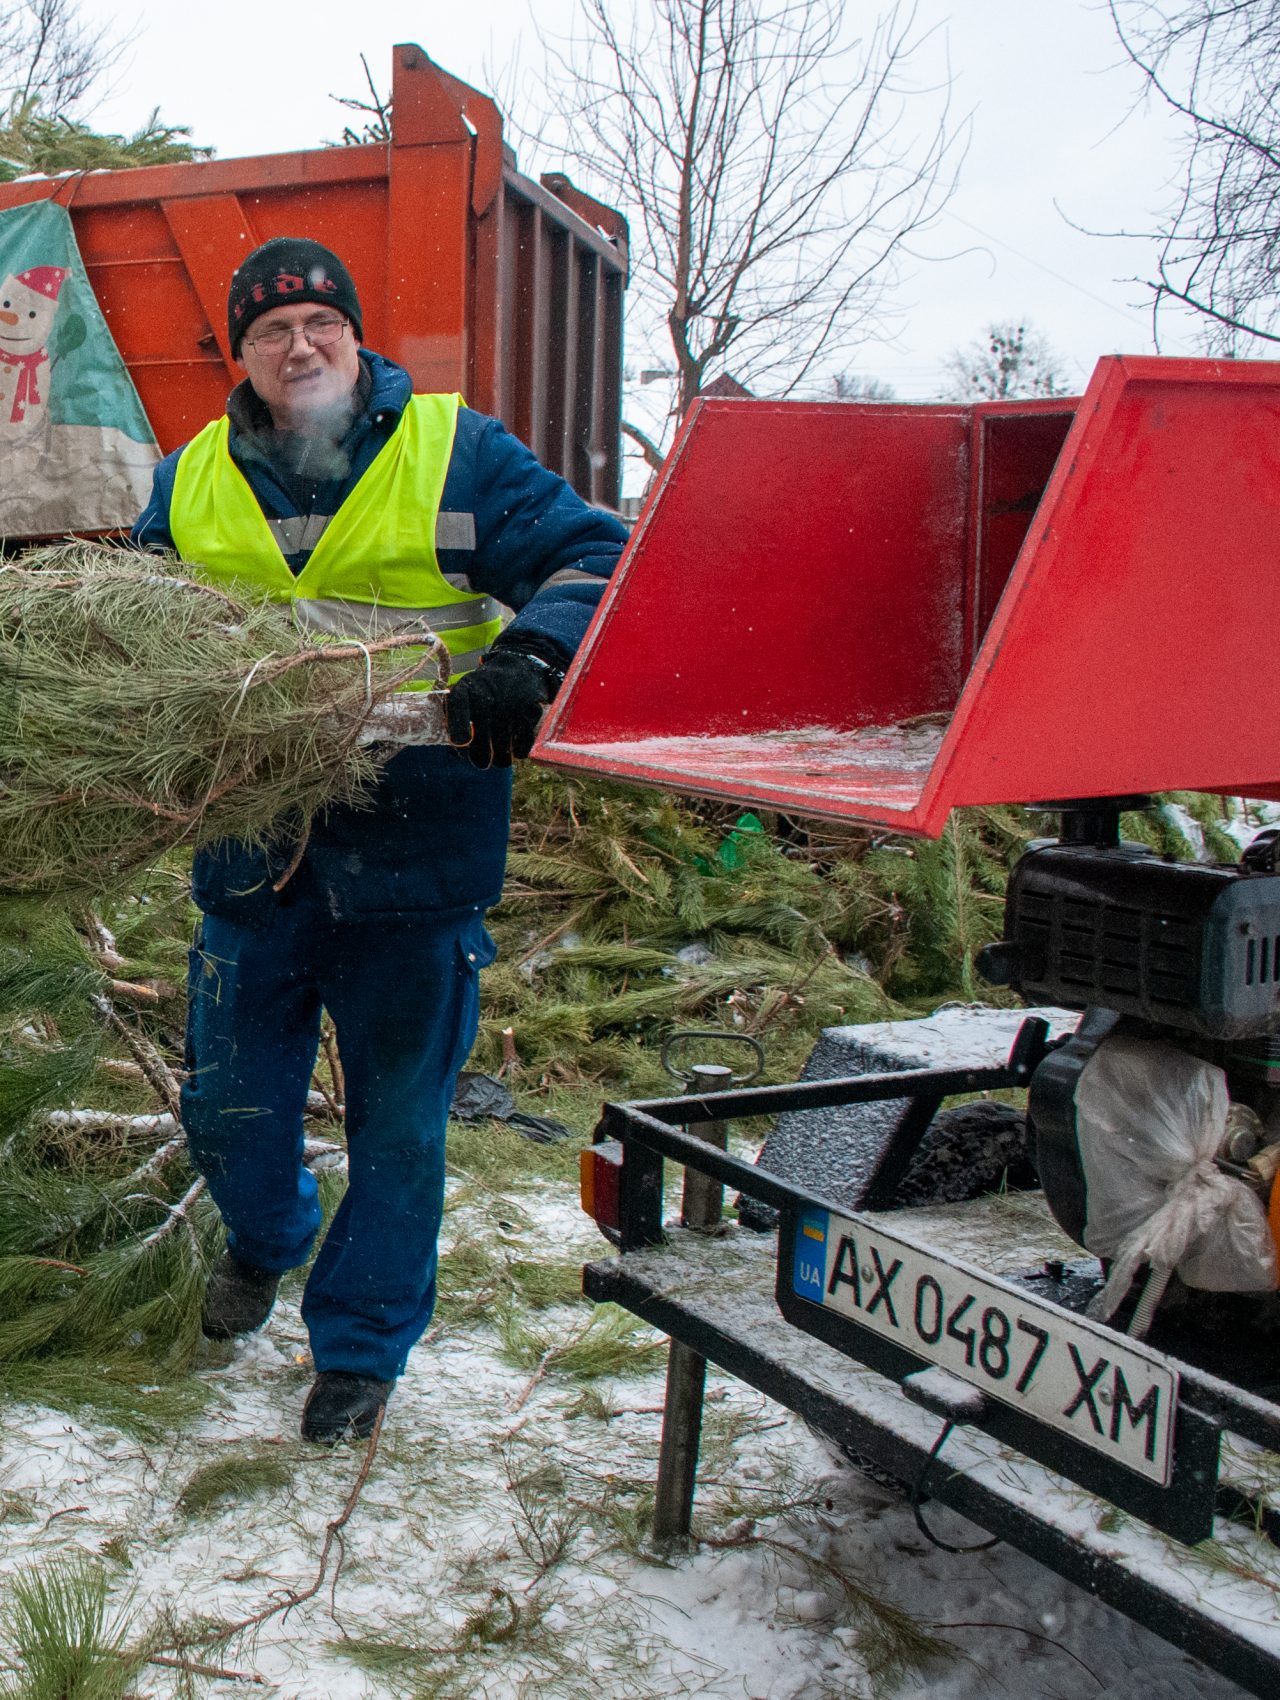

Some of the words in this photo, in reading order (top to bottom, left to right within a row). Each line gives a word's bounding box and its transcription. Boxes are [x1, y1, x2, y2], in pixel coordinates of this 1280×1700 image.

[800, 1261, 821, 1288] UA
[827, 1233, 904, 1328] AX
[914, 1273, 1050, 1394] 0487
[1062, 1341, 1161, 1463] XM
